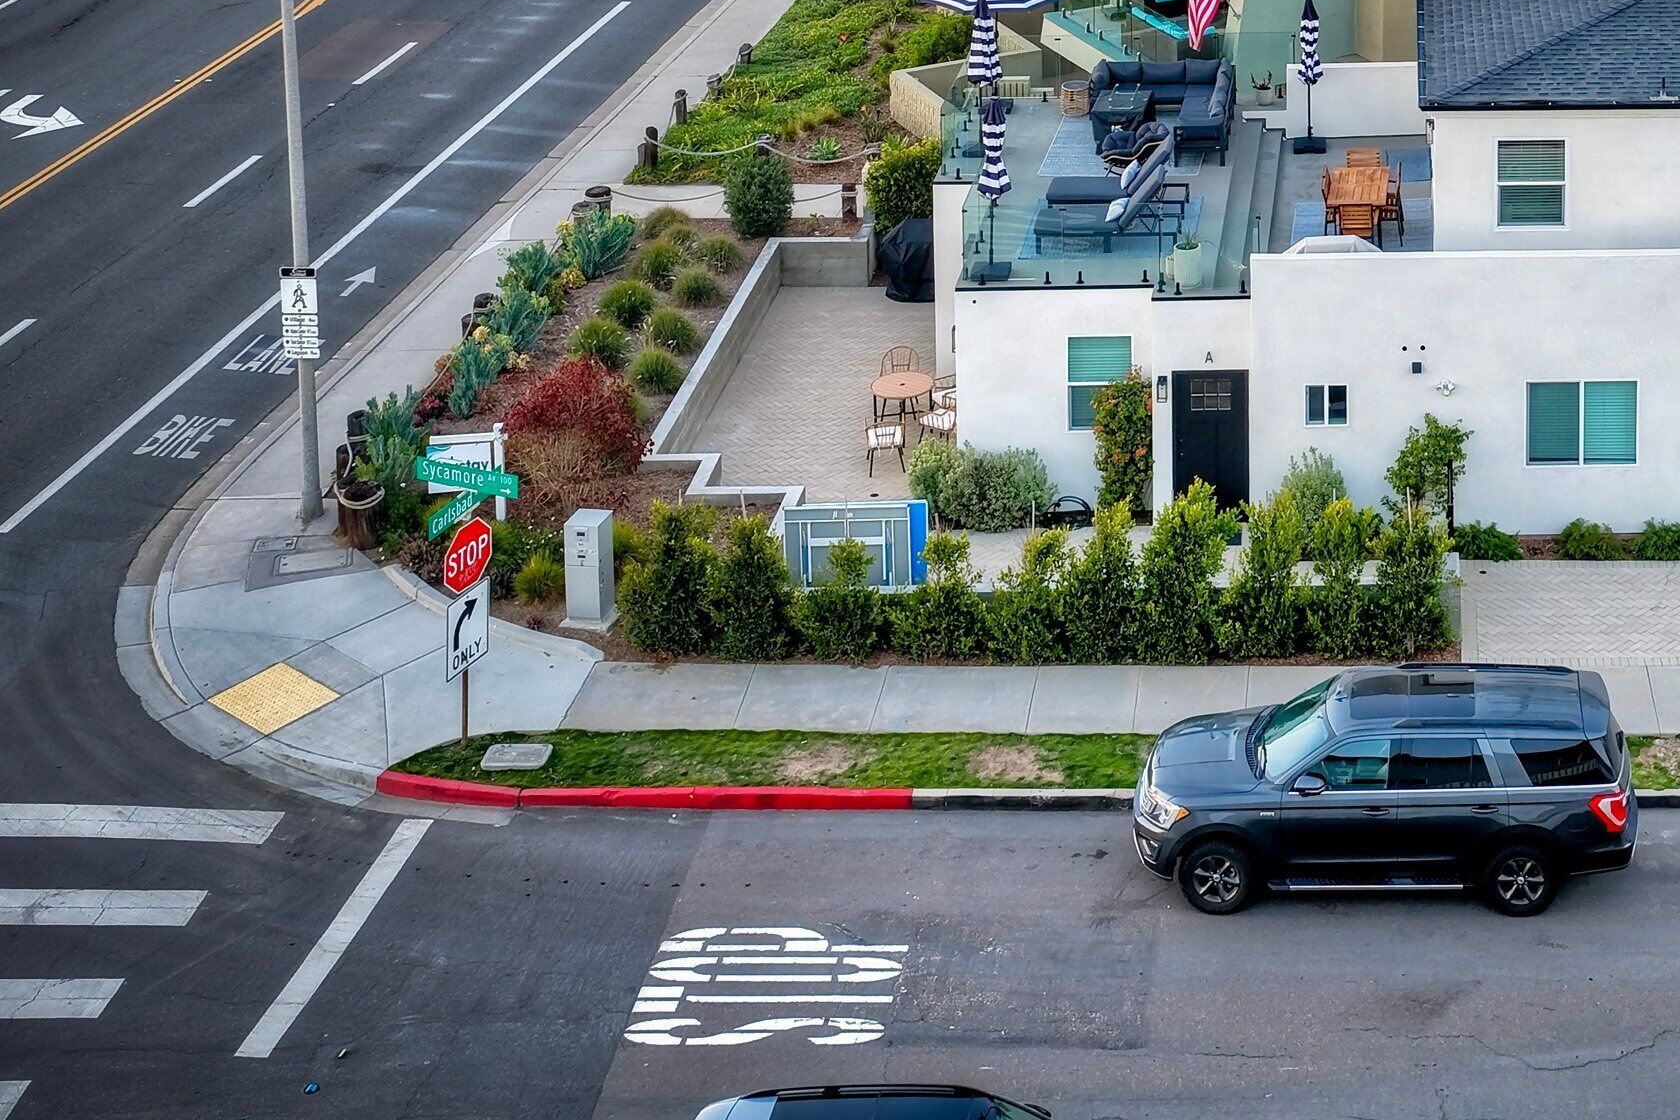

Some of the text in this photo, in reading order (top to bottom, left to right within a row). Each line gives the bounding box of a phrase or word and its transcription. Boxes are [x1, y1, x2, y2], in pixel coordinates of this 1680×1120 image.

[1204, 351, 1214, 364] A
[133, 414, 237, 460] BIKE
[422, 460, 484, 487] Sycamore
[487, 473, 497, 482] Av
[500, 476, 513, 485] 100
[432, 491, 474, 535] Carlsbad
[447, 533, 489, 578] STOP
[452, 636, 483, 671] ONLY
[622, 926, 910, 1046] STOP
